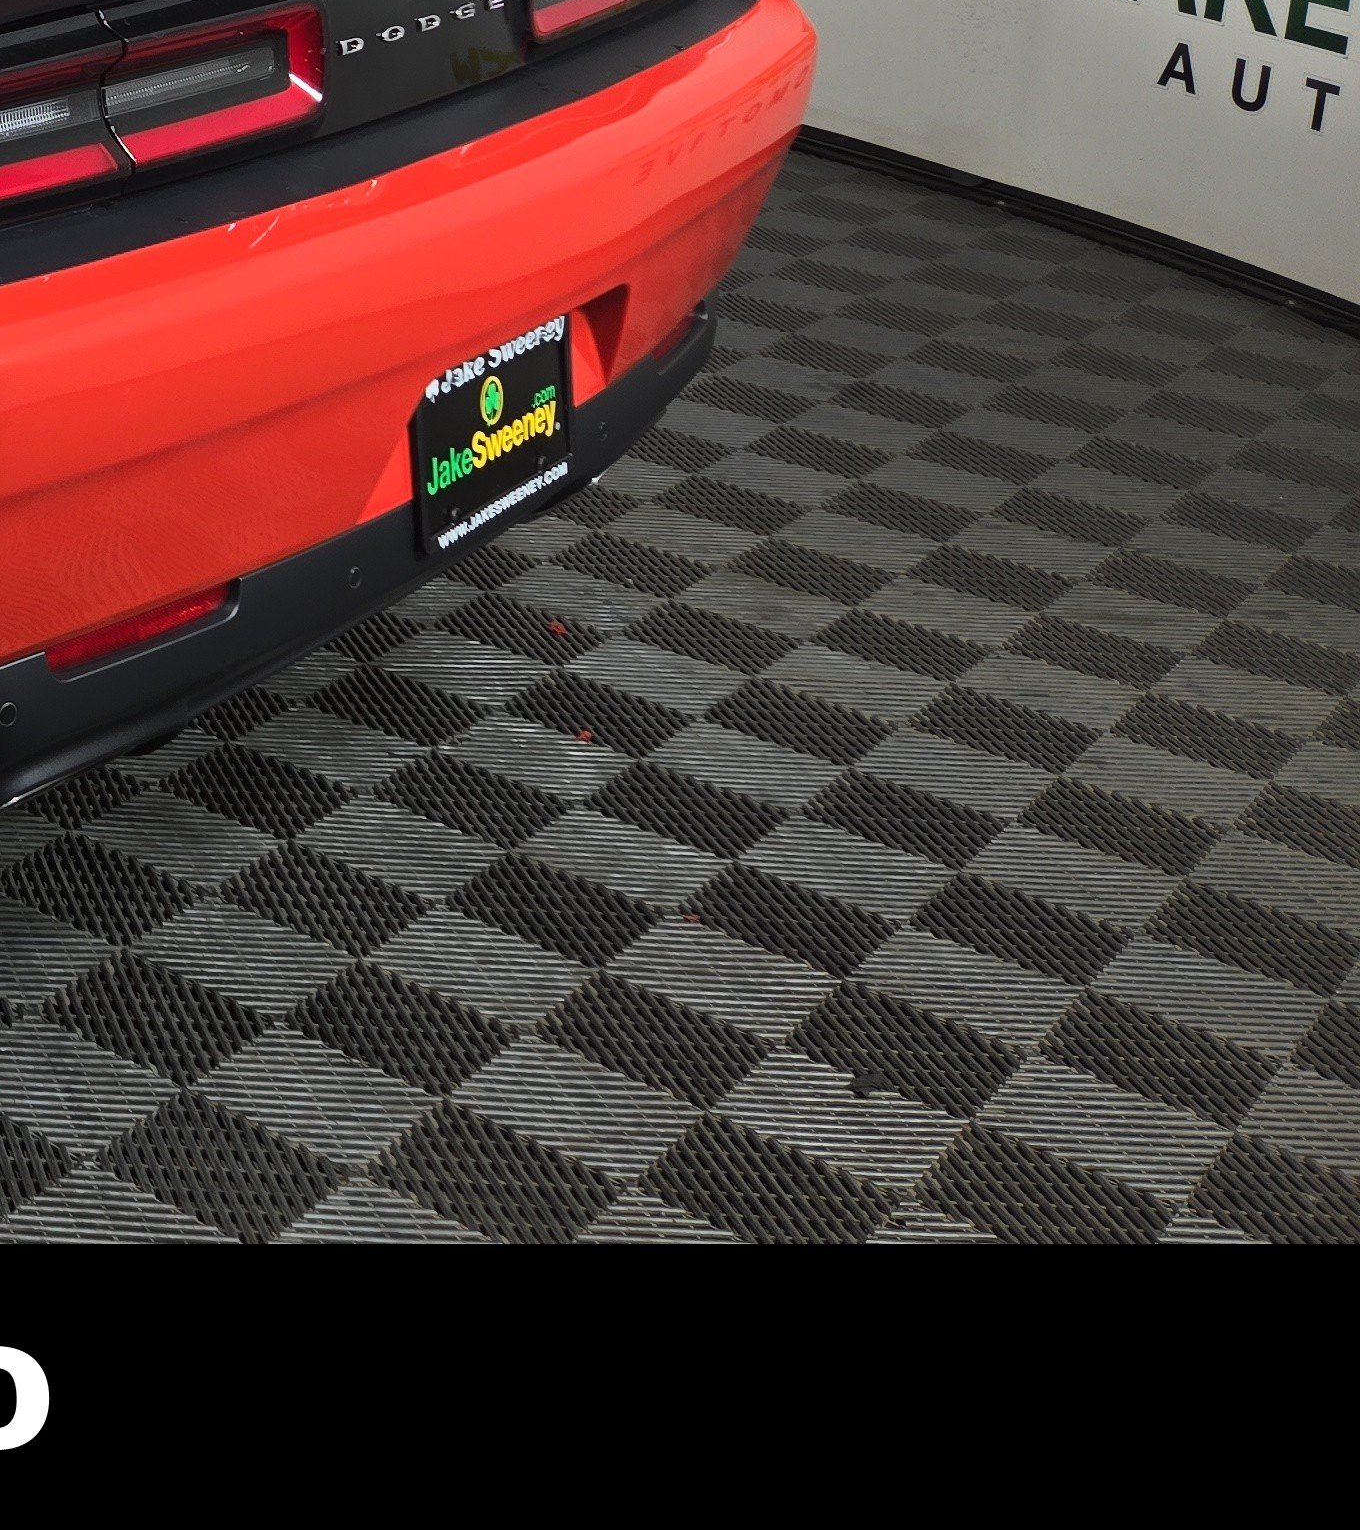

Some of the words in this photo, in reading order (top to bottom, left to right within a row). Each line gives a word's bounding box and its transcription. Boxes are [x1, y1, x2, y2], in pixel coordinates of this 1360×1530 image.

[1156, 42, 1341, 132] AUT
[440, 356, 486, 394] Jake
[487, 315, 566, 369] Sweeney
